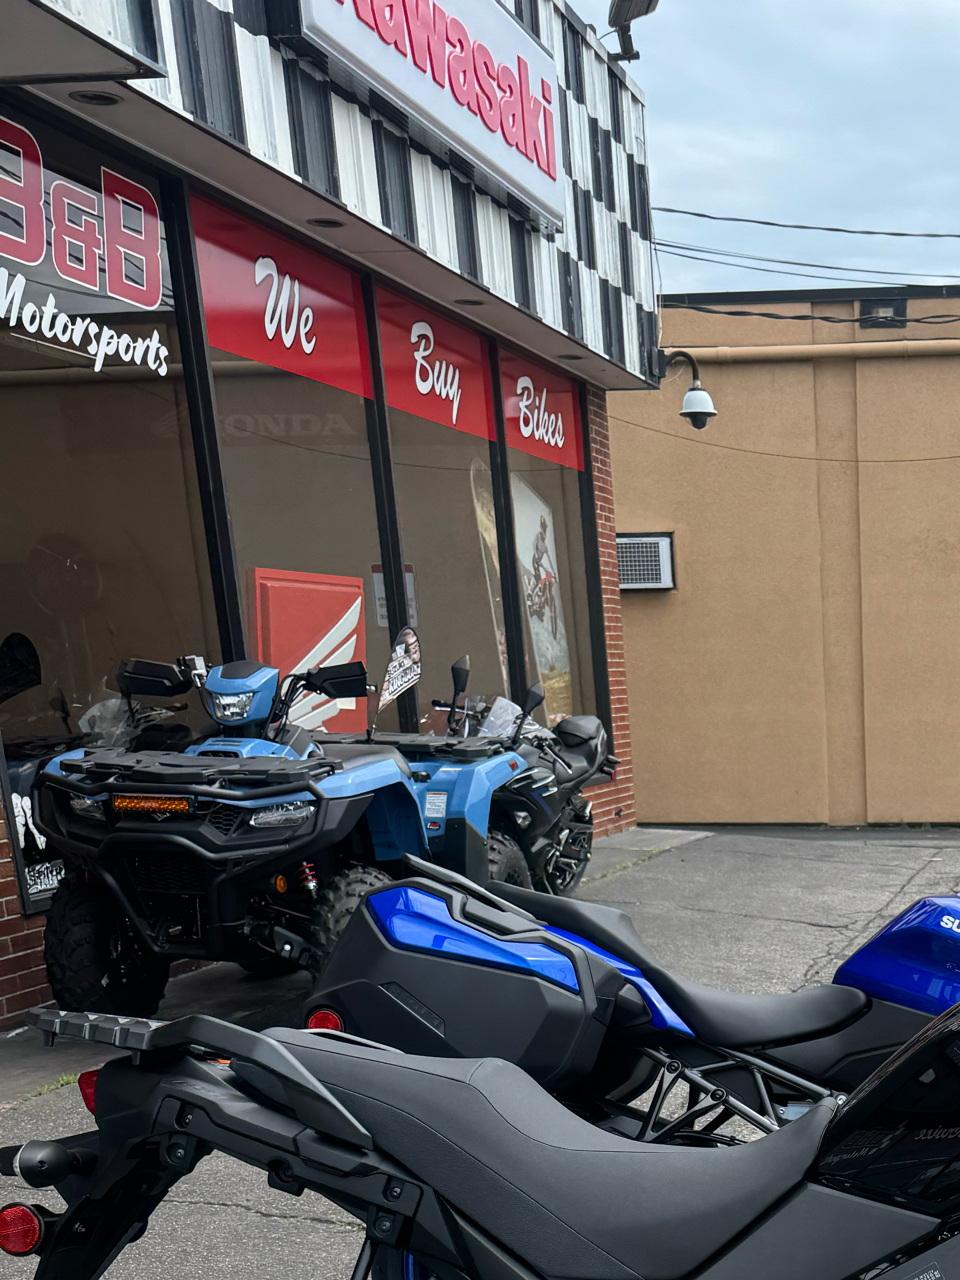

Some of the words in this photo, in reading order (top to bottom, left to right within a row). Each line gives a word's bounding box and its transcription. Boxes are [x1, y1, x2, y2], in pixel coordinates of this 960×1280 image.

[0, 267, 168, 377] Motorsports
[255, 256, 317, 355] We
[410, 321, 461, 424] Buy
[516, 376, 565, 448] Bikes
[219, 413, 357, 436] ONDA
